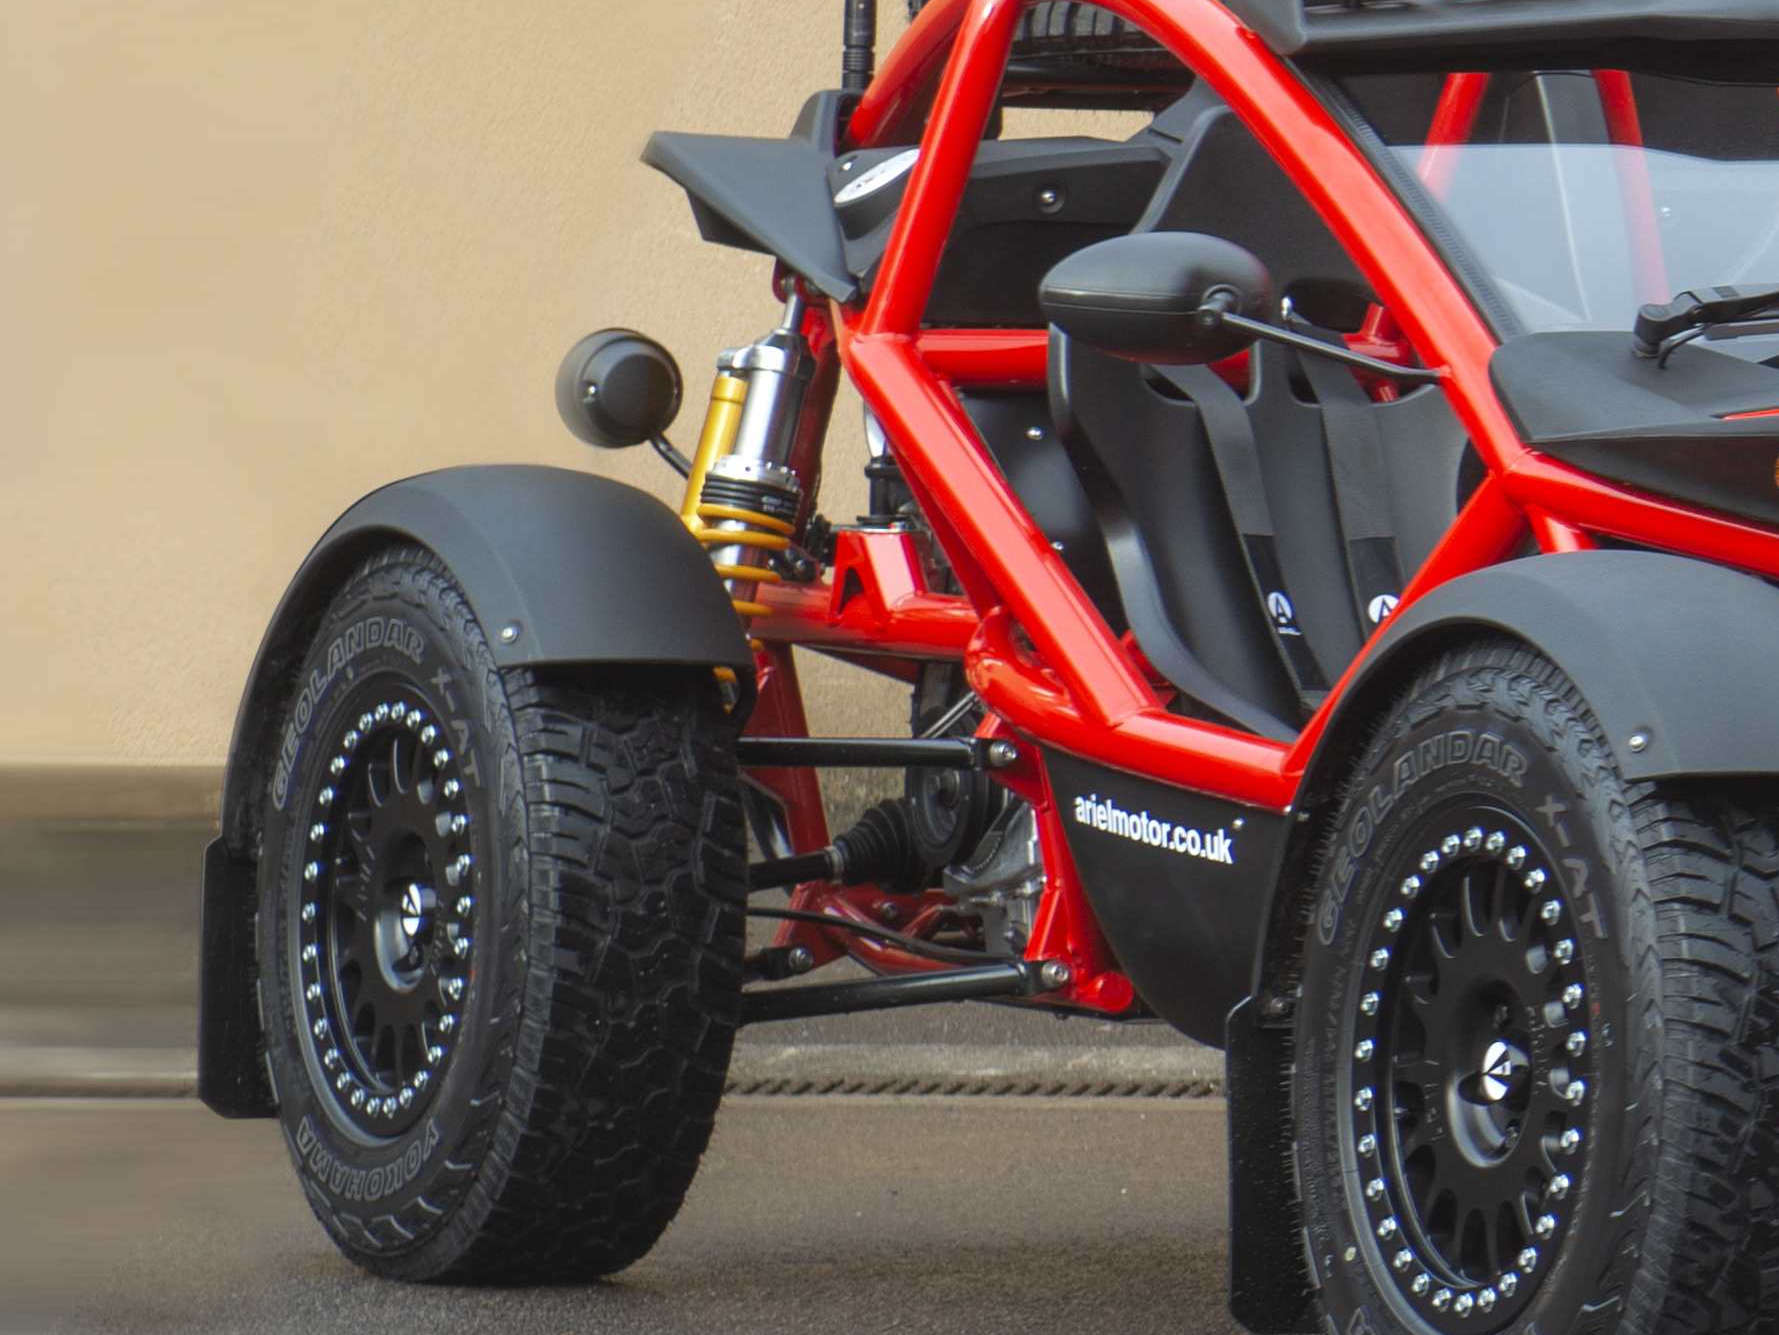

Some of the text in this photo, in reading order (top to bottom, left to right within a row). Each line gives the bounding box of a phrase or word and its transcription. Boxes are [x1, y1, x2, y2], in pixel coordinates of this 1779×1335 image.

[273, 616, 482, 811] GEOLANDAR X-AT
[1073, 793, 1235, 865] arielmotor.co.uk
[1316, 730, 1528, 946] GEOLANDAR
[1535, 793, 1610, 939] X-AT
[296, 1115, 440, 1203] YOKOHAMA
